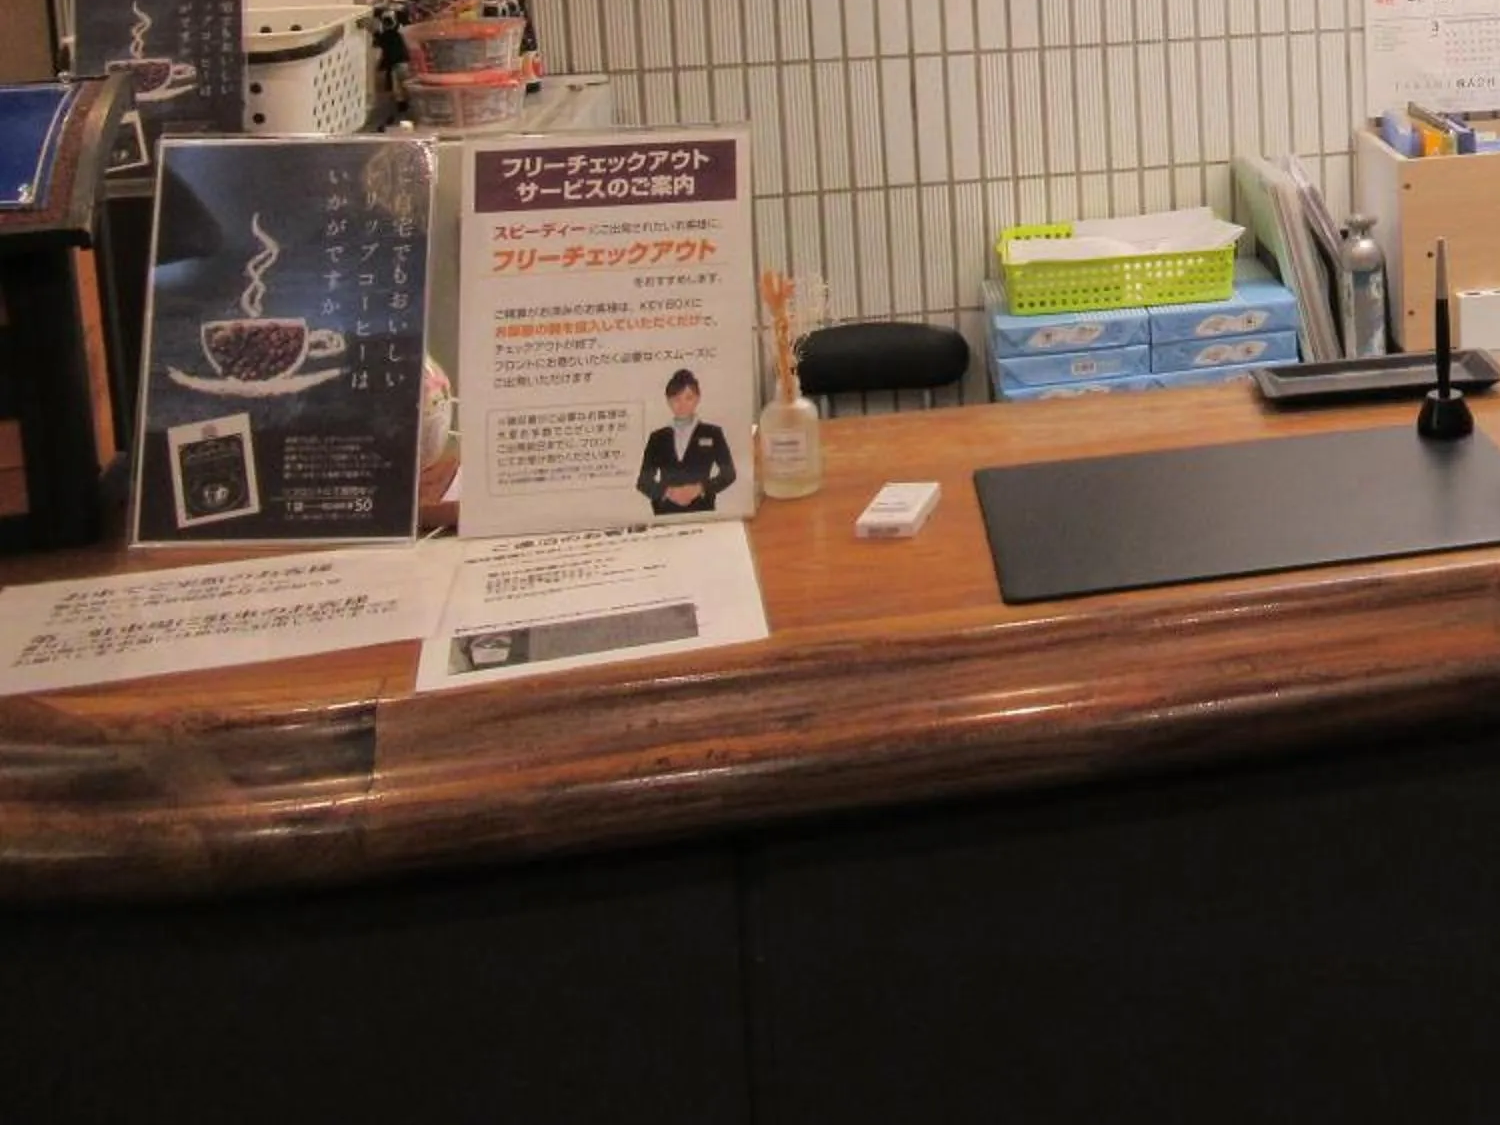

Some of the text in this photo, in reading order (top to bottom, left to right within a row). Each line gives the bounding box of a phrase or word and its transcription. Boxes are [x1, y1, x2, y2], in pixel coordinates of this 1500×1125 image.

[502, 148, 710, 177] フリーチェックアウト
[516, 175, 696, 203] サービスのご案内
[491, 238, 718, 273] フリーチェックアウト
